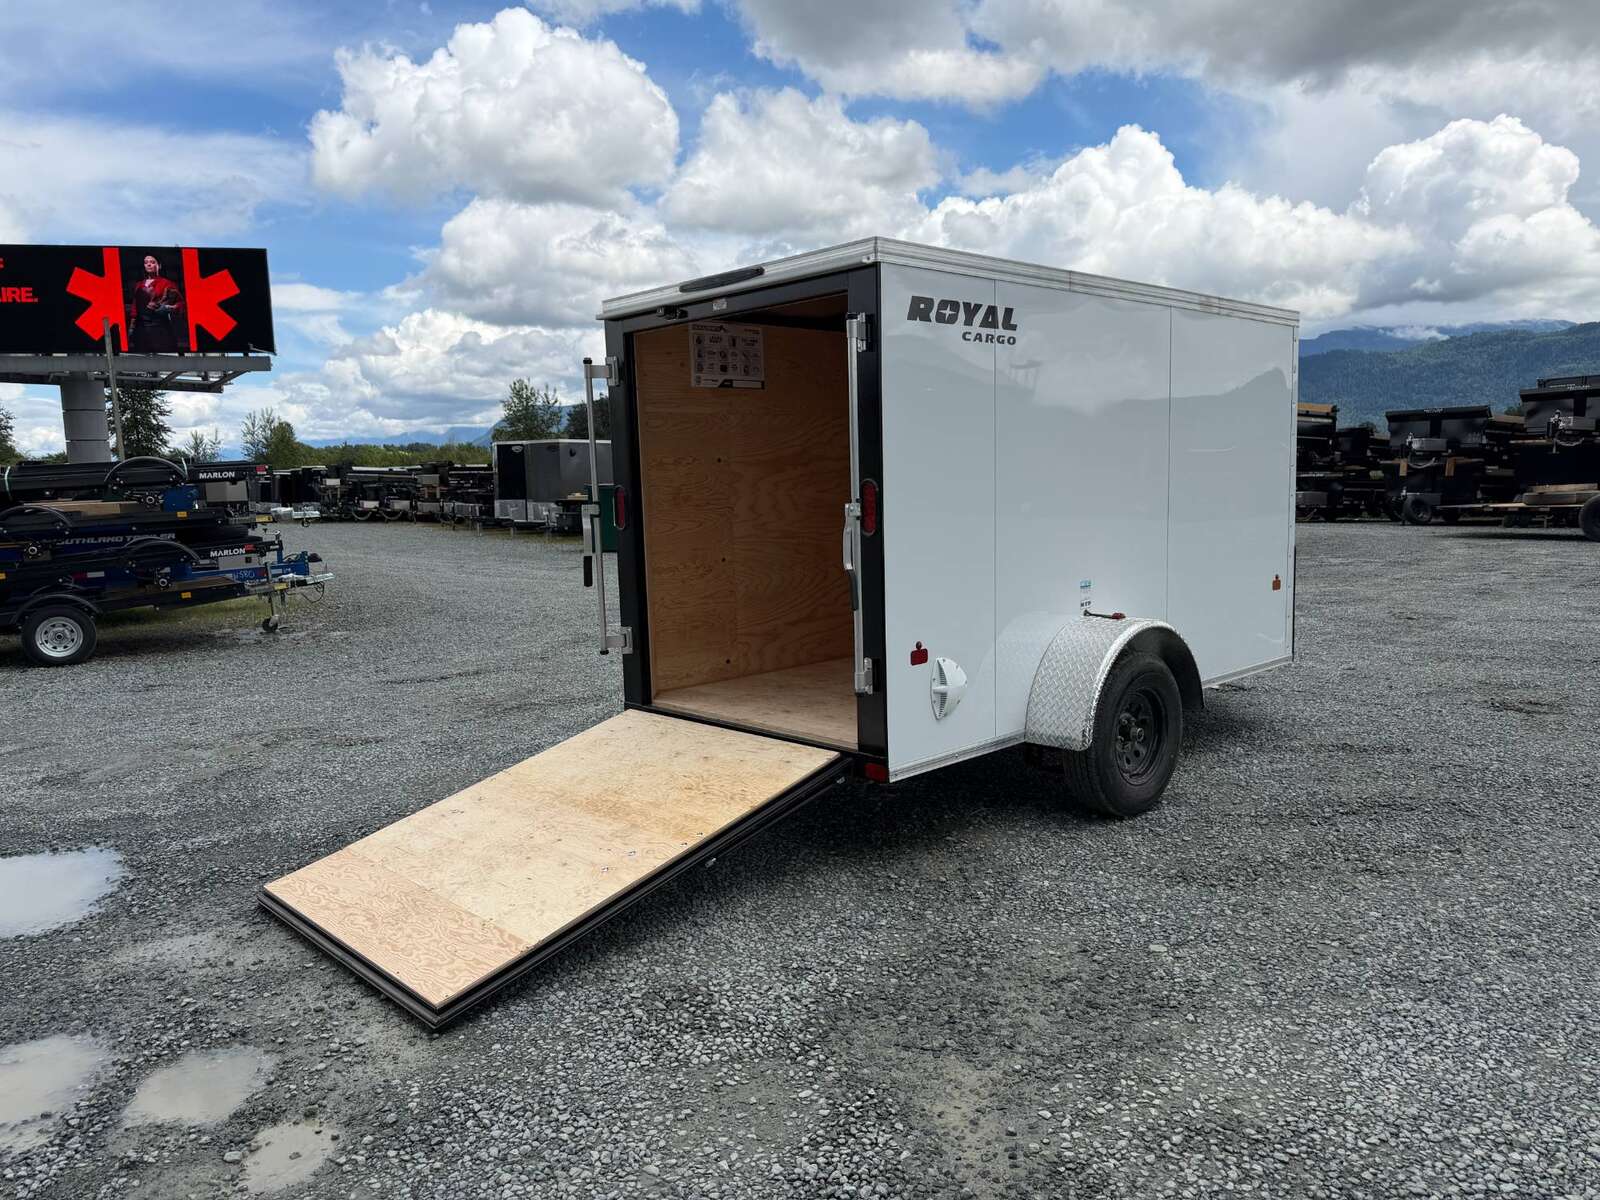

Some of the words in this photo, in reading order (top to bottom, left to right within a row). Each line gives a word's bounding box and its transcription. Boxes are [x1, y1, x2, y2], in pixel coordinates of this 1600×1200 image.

[0, 286, 38, 303] IRE.
[907, 295, 1017, 331] ROYAL
[962, 331, 1017, 345] CARGO
[198, 471, 236, 480] MARLON
[48, 535, 124, 547] OUTHLAND
[209, 547, 246, 558] MARLON
